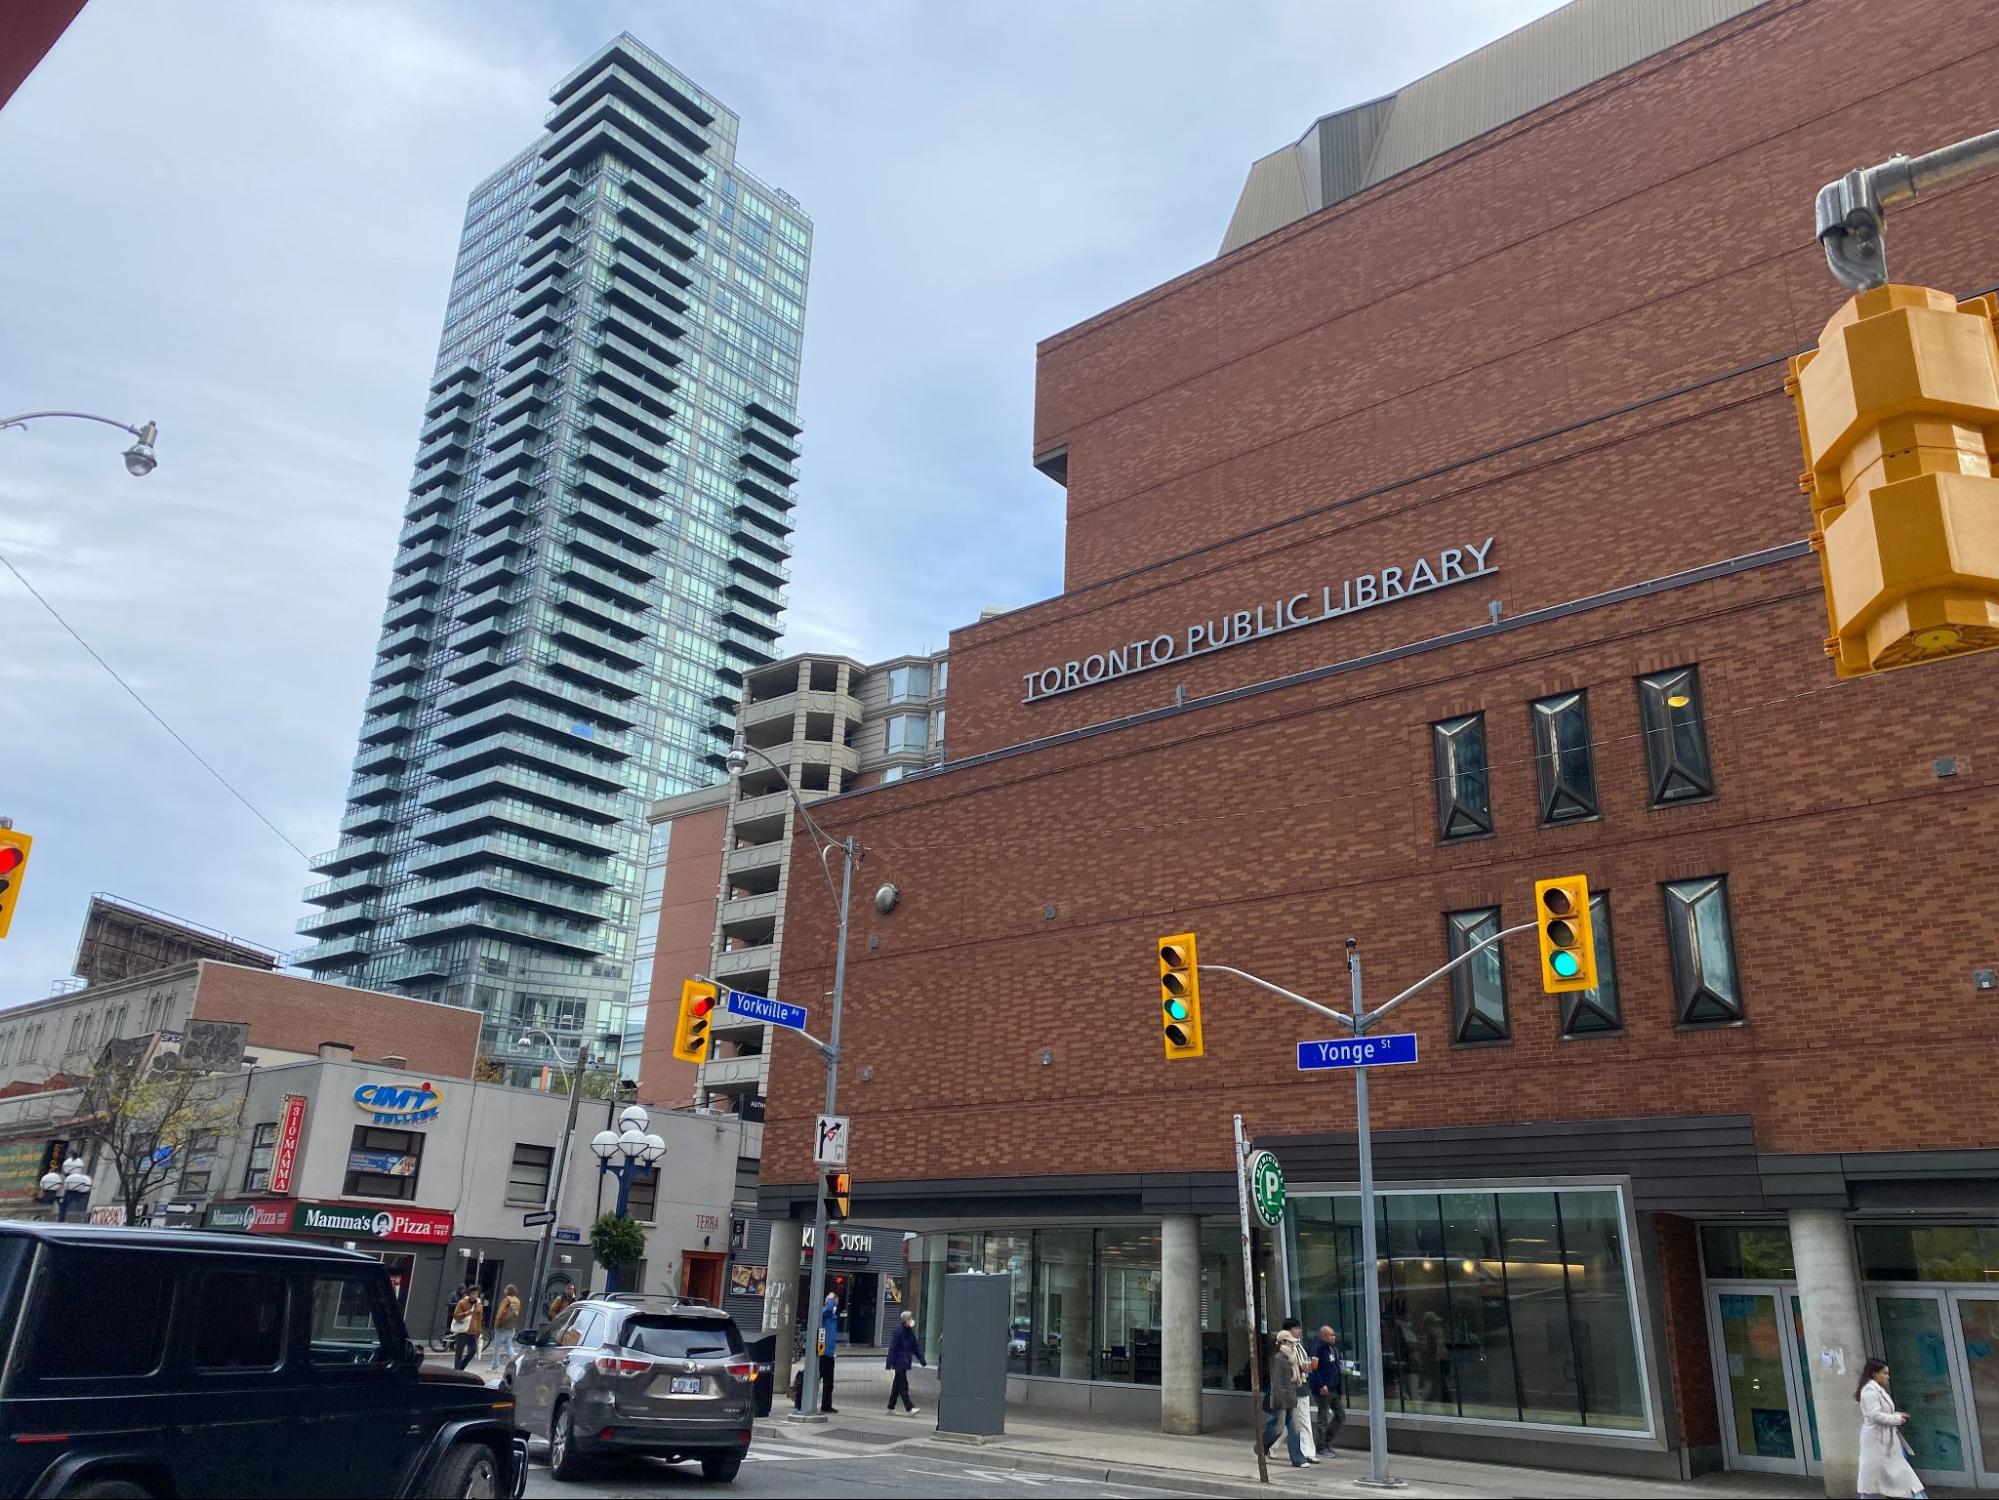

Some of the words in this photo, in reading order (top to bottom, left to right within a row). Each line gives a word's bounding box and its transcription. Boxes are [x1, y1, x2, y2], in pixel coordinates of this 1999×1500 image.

[1023, 634, 1174, 700] TORONTO
[1187, 593, 1309, 655] PUBLIC
[1323, 537, 1494, 616] LIBRARY
[737, 994, 788, 1020] Yorkville
[1318, 1043, 1375, 1064] Yonge
[1381, 1039, 1391, 1049] St
[352, 1084, 438, 1111] CIMT
[1265, 1170, 1279, 1200] P
[211, 1210, 243, 1226] Mamma's
[254, 1207, 276, 1225] Pizza
[305, 1209, 371, 1231] Mamma's
[395, 1217, 430, 1235] Pizza
[696, 1214, 719, 1230] TERRA
[840, 1233, 872, 1252] SUSHI
